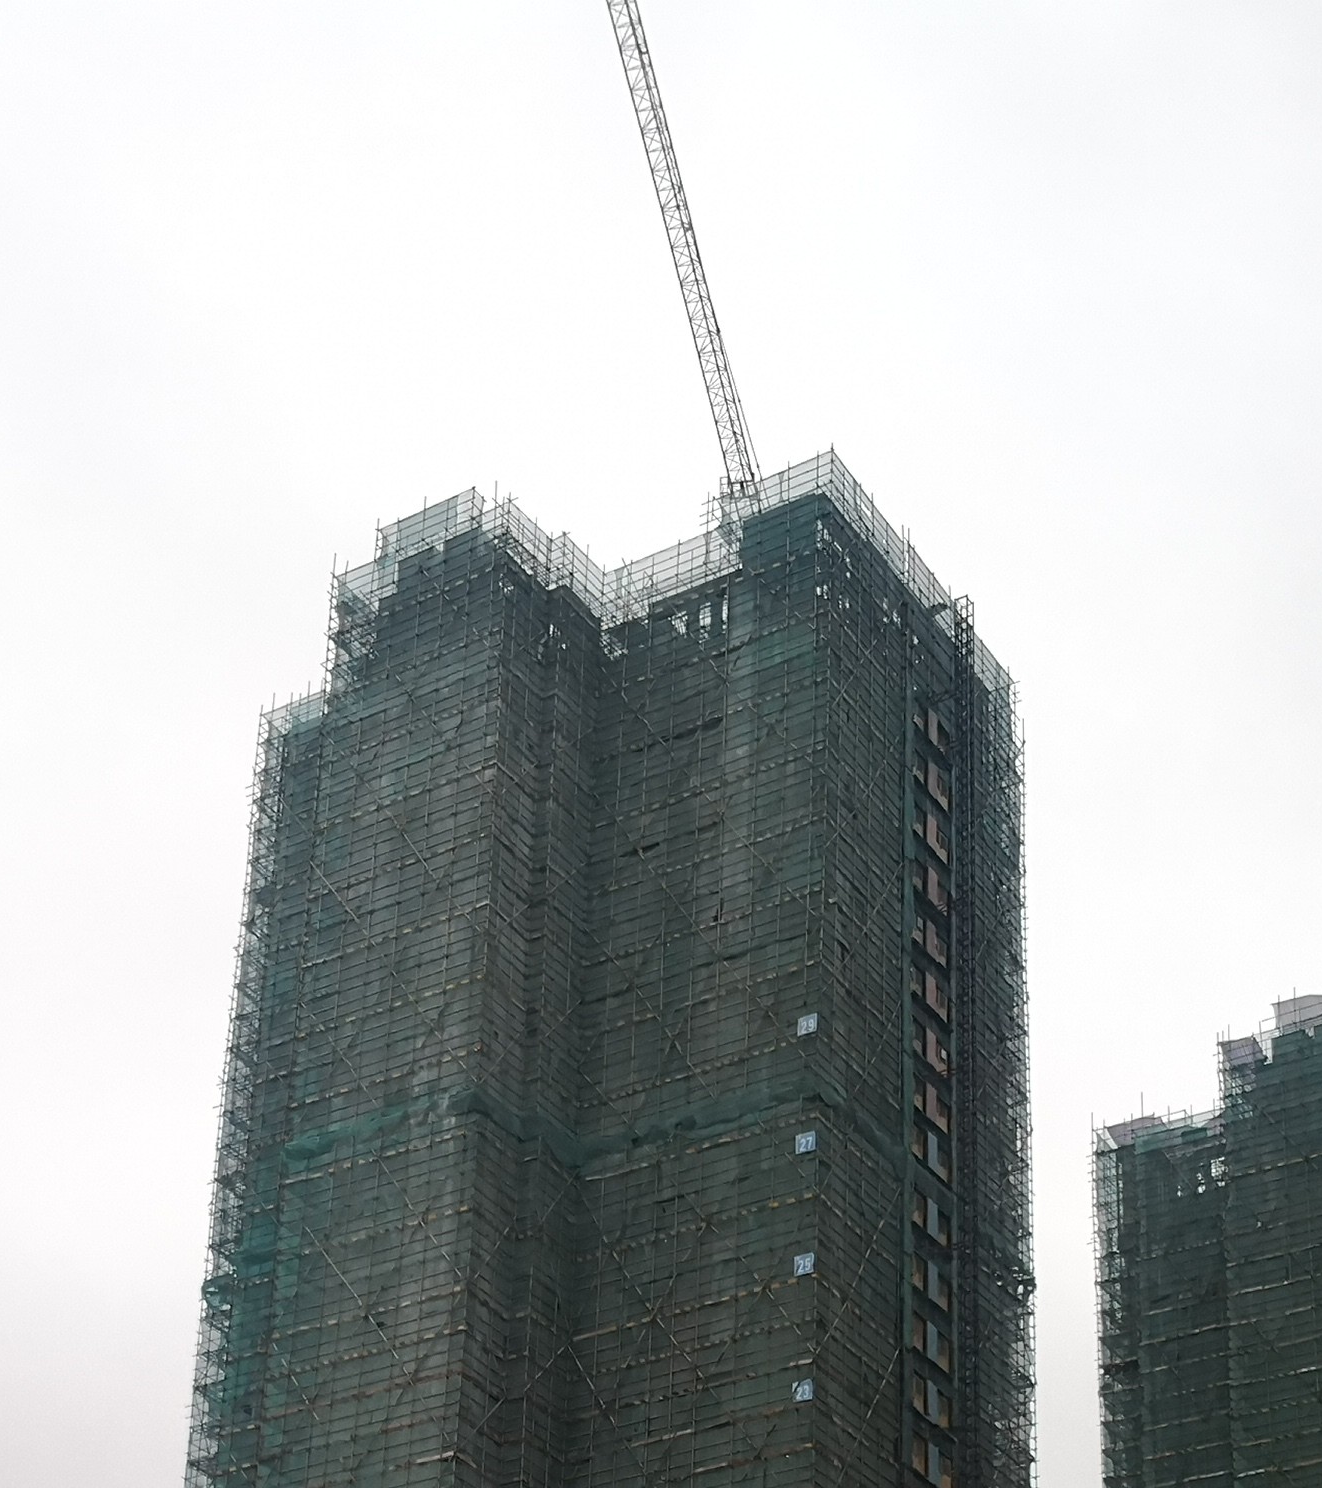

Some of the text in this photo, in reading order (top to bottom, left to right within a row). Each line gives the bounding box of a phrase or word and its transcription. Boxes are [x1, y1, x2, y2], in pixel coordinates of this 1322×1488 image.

[800, 1020, 815, 1034] 29
[799, 1136, 813, 1152] 27
[798, 1257, 812, 1273] 25
[796, 1384, 809, 1400] 23
